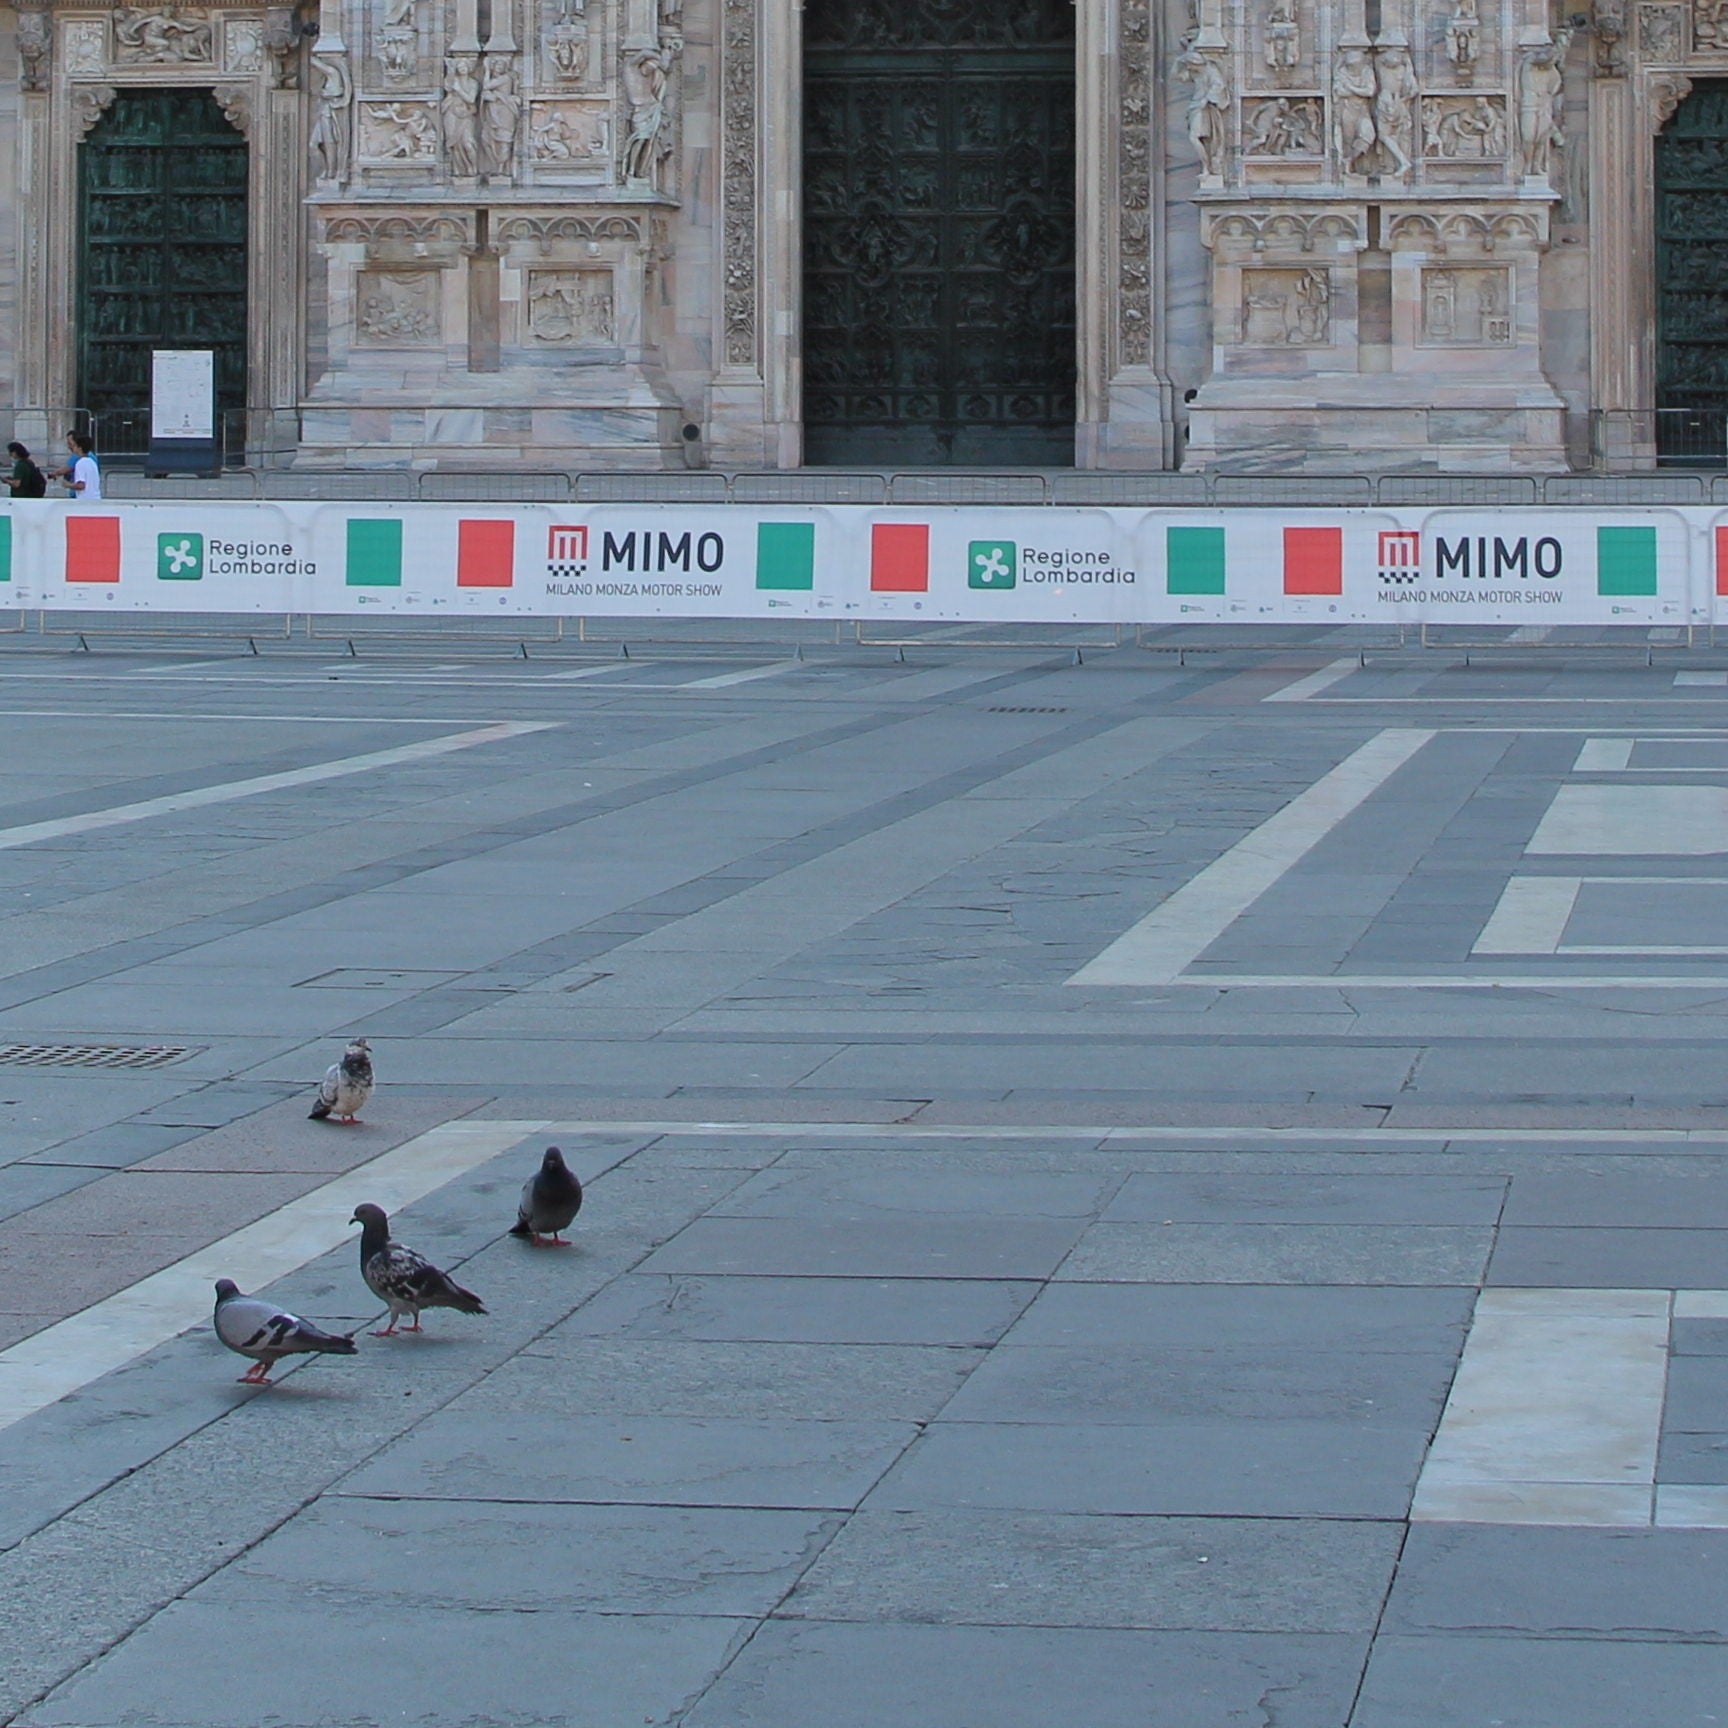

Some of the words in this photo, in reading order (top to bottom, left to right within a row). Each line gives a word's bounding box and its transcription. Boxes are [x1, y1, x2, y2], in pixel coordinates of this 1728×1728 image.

[210, 540, 293, 557] Regione
[602, 531, 724, 572] MIMO
[1023, 548, 1110, 566] Regione
[1436, 537, 1562, 578] MIMO
[210, 560, 316, 574] Lombardia
[1023, 568, 1135, 583] Lombardia
[546, 584, 592, 595] MILANO
[596, 584, 639, 595] MONZA
[642, 584, 683, 595] MOTOR
[686, 584, 722, 596] SHOW
[1378, 590, 1427, 603] MILANO
[1431, 590, 1475, 603] MONZA
[1478, 590, 1521, 603] MOTOR
[1524, 590, 1563, 603] SHOW
